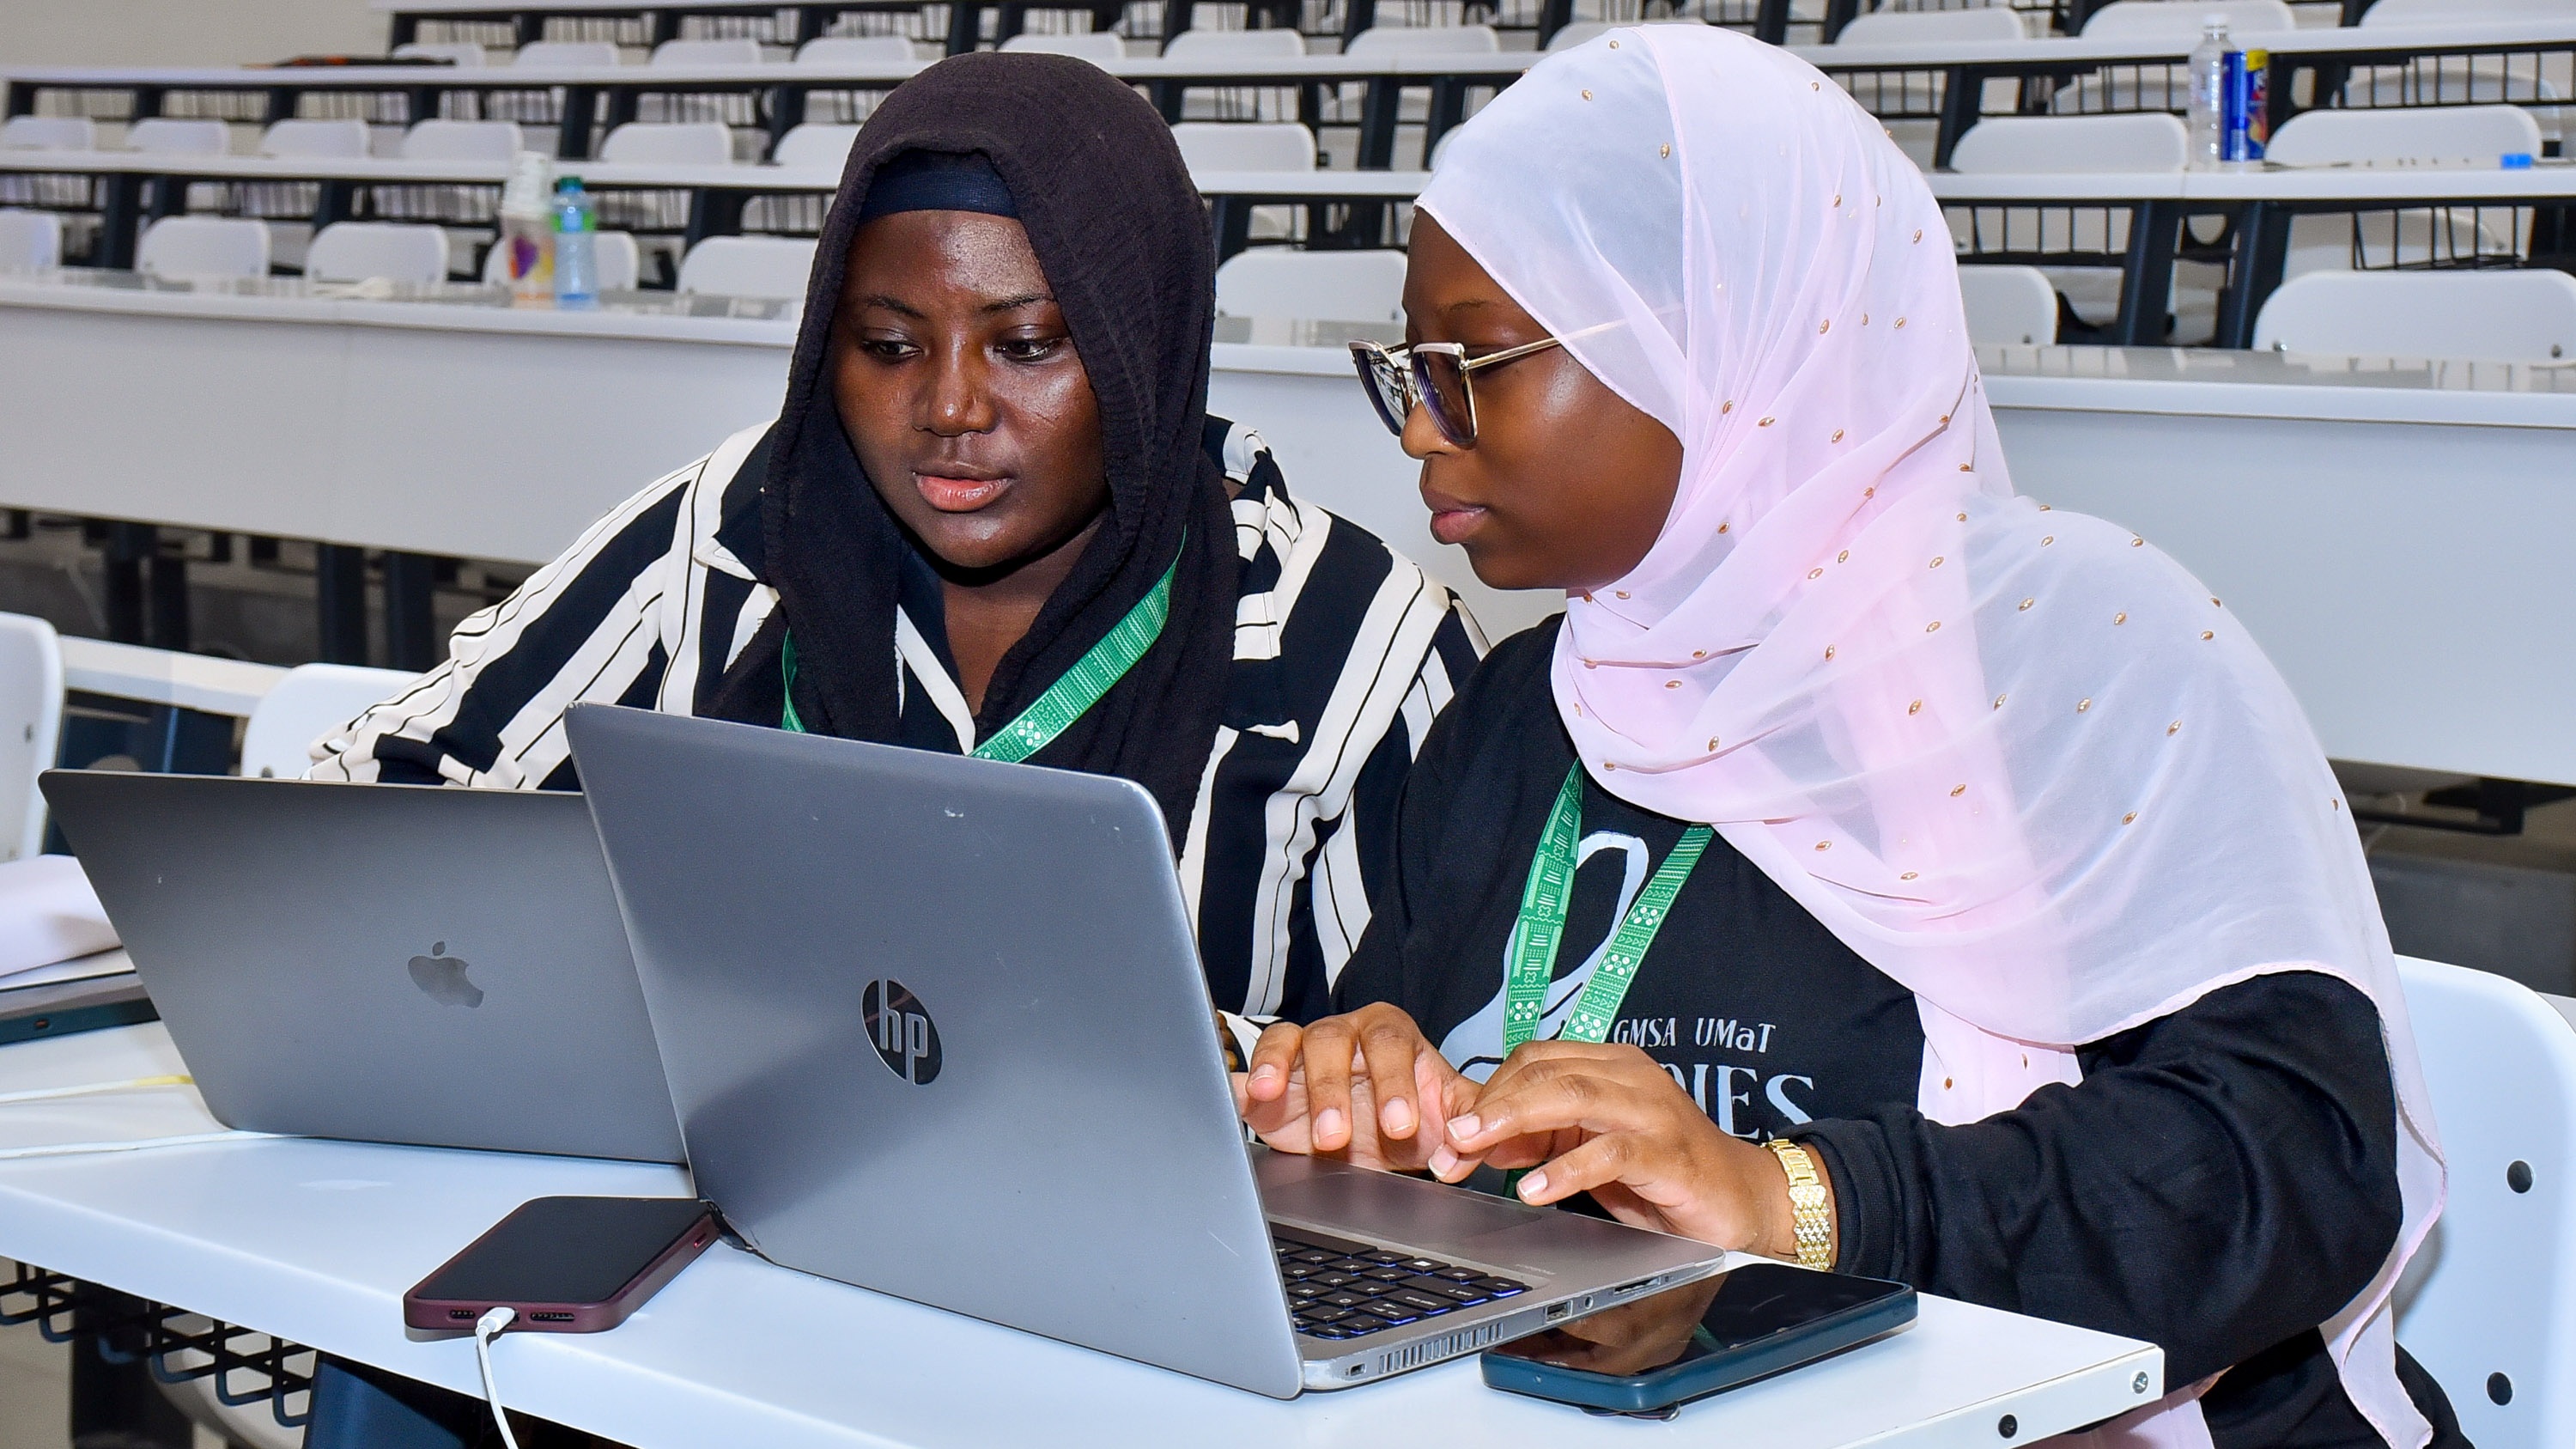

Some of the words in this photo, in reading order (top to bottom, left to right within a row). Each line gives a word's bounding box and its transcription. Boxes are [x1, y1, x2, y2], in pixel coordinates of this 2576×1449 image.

[878, 977, 928, 1085] hp
[1614, 1017, 1676, 1048] GMSA
[1695, 1017, 1776, 1053] UMaT
